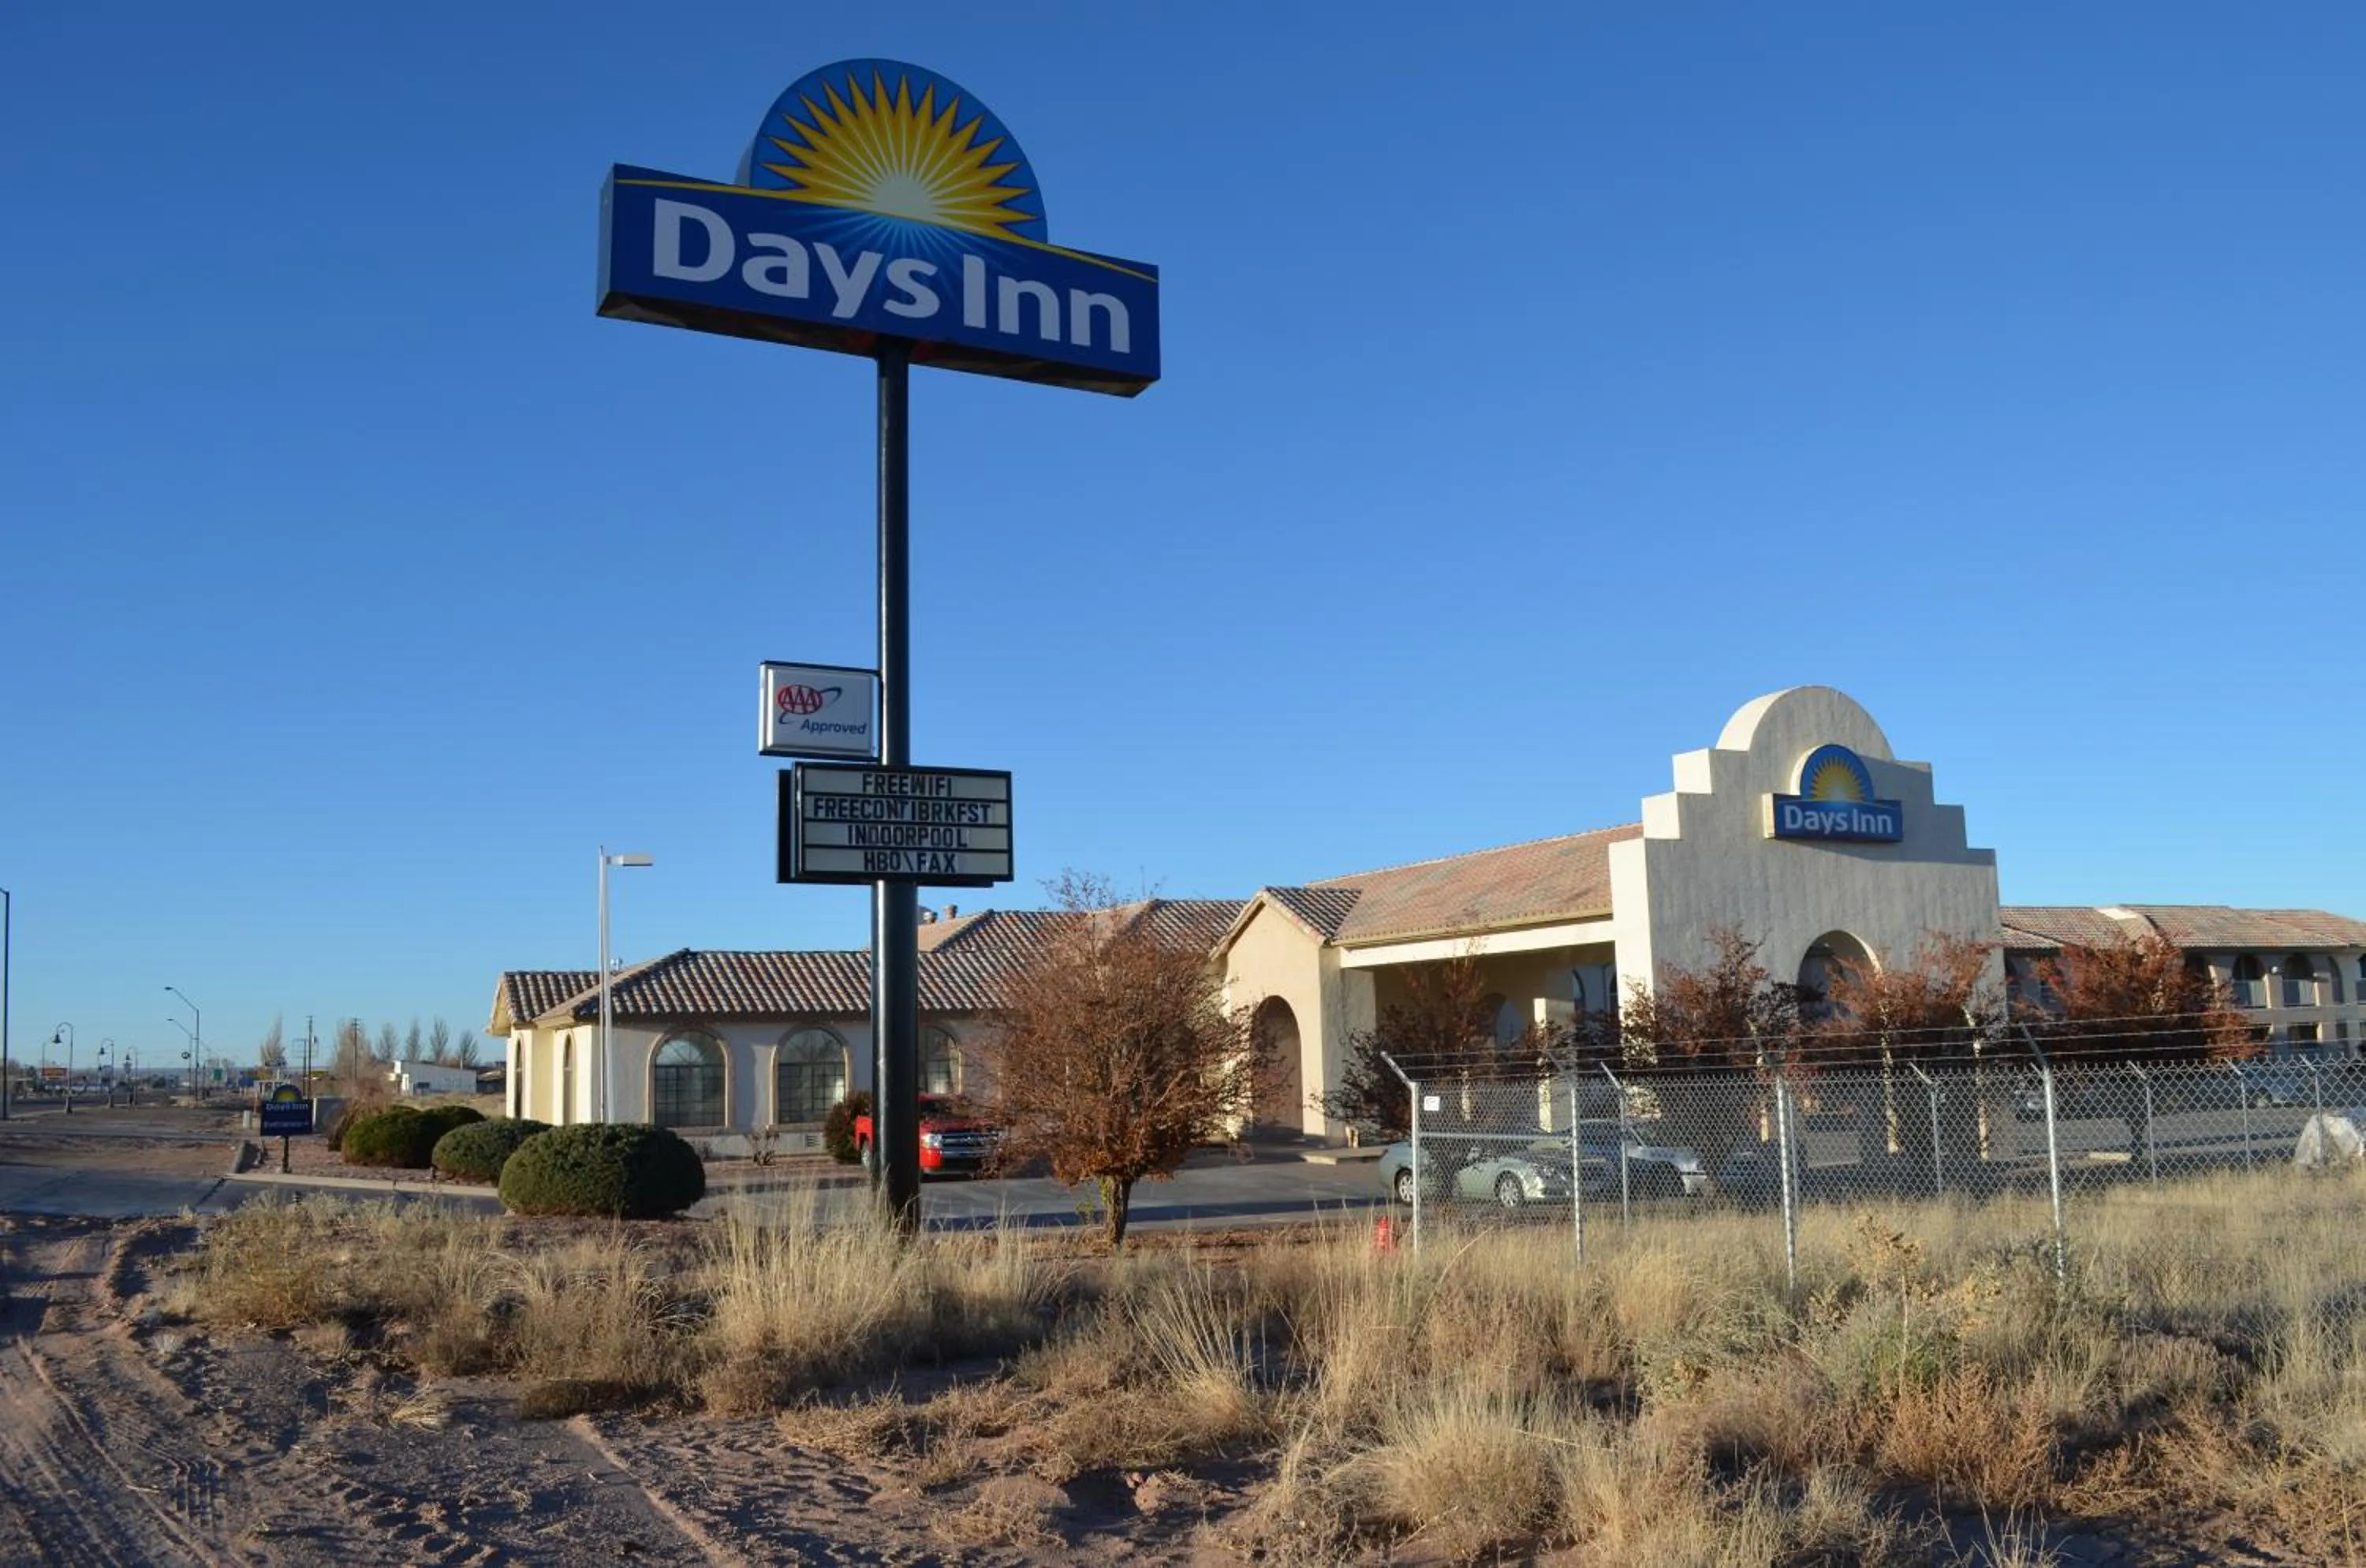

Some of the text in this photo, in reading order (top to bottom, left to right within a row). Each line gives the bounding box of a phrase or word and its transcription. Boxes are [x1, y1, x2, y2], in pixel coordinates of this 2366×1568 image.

[652, 197, 1132, 354] Days Inn
[781, 685, 819, 714] AAA
[800, 719, 868, 735] Approved
[1784, 805, 1894, 834] Days Inn
